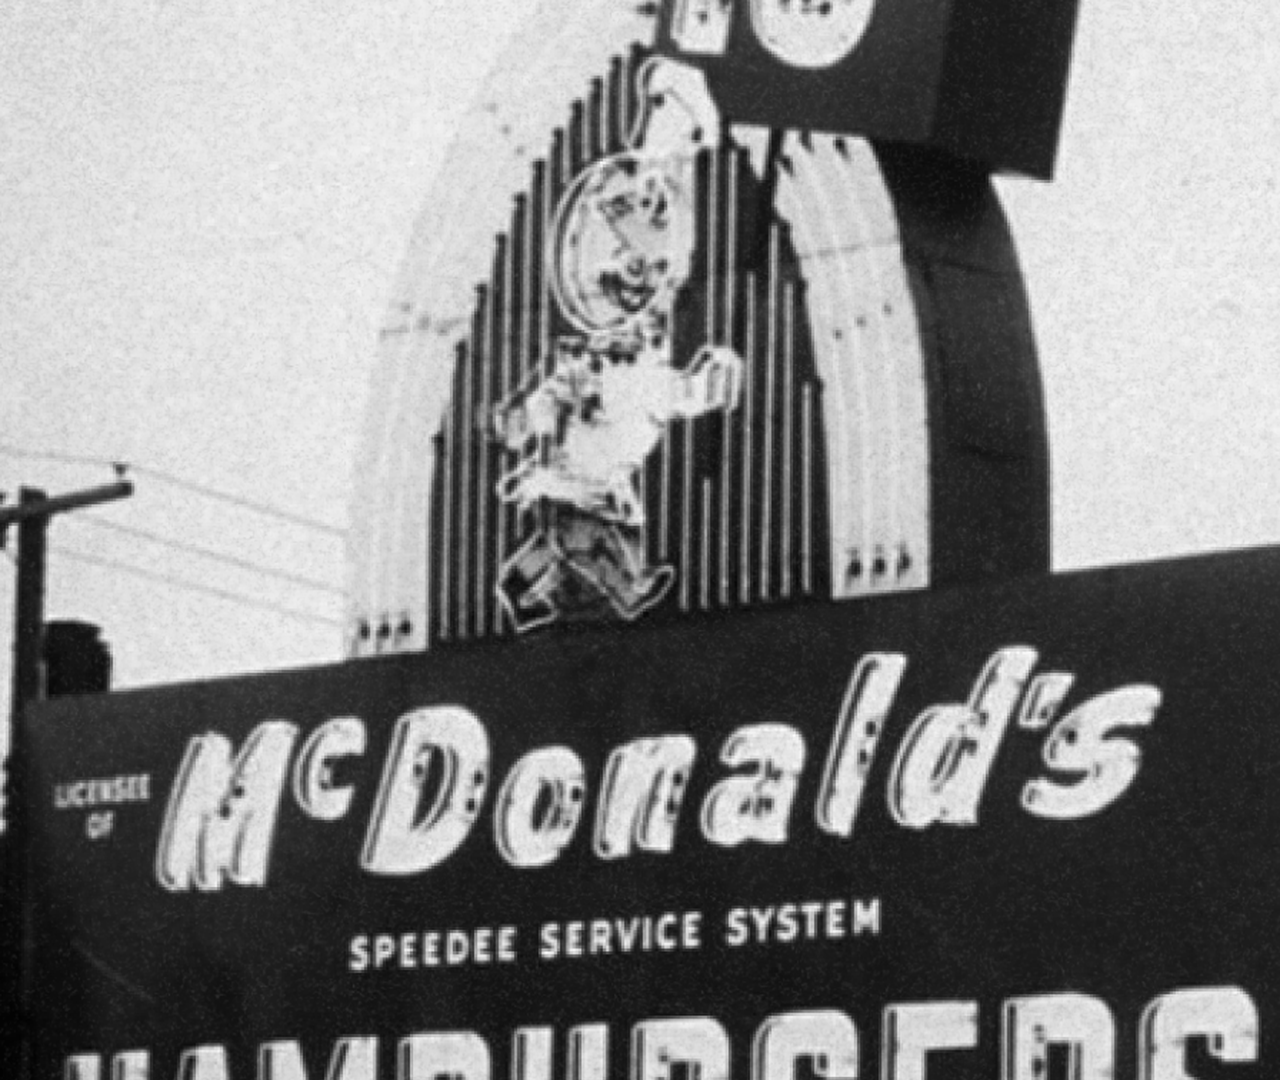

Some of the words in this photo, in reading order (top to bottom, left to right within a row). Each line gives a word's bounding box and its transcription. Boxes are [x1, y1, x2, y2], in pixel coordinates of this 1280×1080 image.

[86, 810, 115, 839] OF
[349, 927, 517, 972] SPEEDEE
[541, 911, 701, 959] SERVICE
[726, 899, 880, 946] SYSTEM
